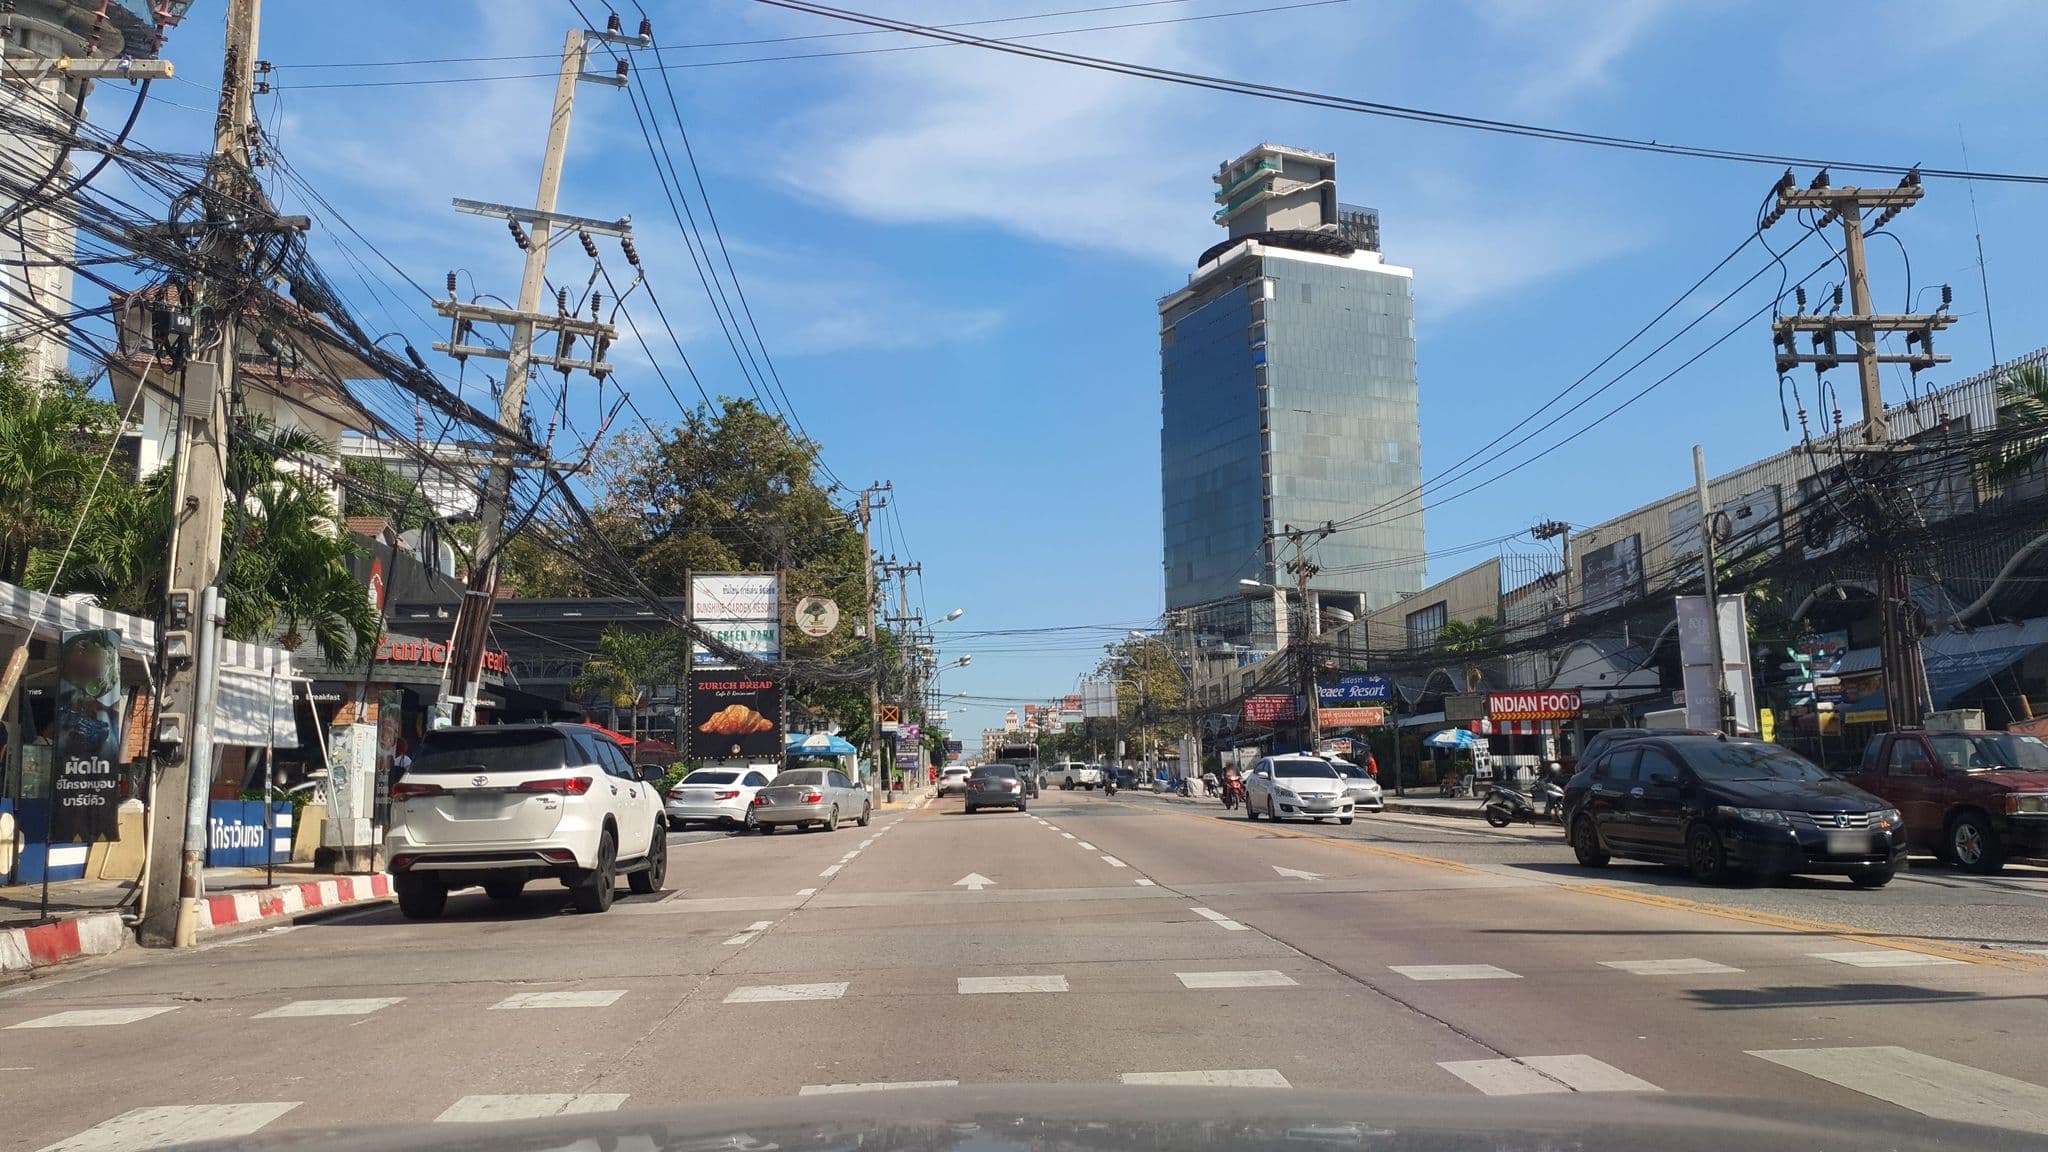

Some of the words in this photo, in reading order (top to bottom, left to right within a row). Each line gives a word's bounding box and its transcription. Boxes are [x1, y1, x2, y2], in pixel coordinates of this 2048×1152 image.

[696, 602, 726, 614] SUNSHINE
[727, 602, 752, 613] GARDEN
[753, 602, 777, 613] RESORT
[717, 630, 747, 642] GREEN
[376, 633, 455, 664] Zurich
[482, 648, 509, 674] read
[698, 682, 737, 690] ZURICH
[739, 681, 772, 690] BREAD
[1349, 685, 1385, 697] Resort
[1490, 696, 1538, 713] INDIAN
[1540, 694, 1581, 711] FOOD
[63, 794, 106, 807] บาร์บีคิว
